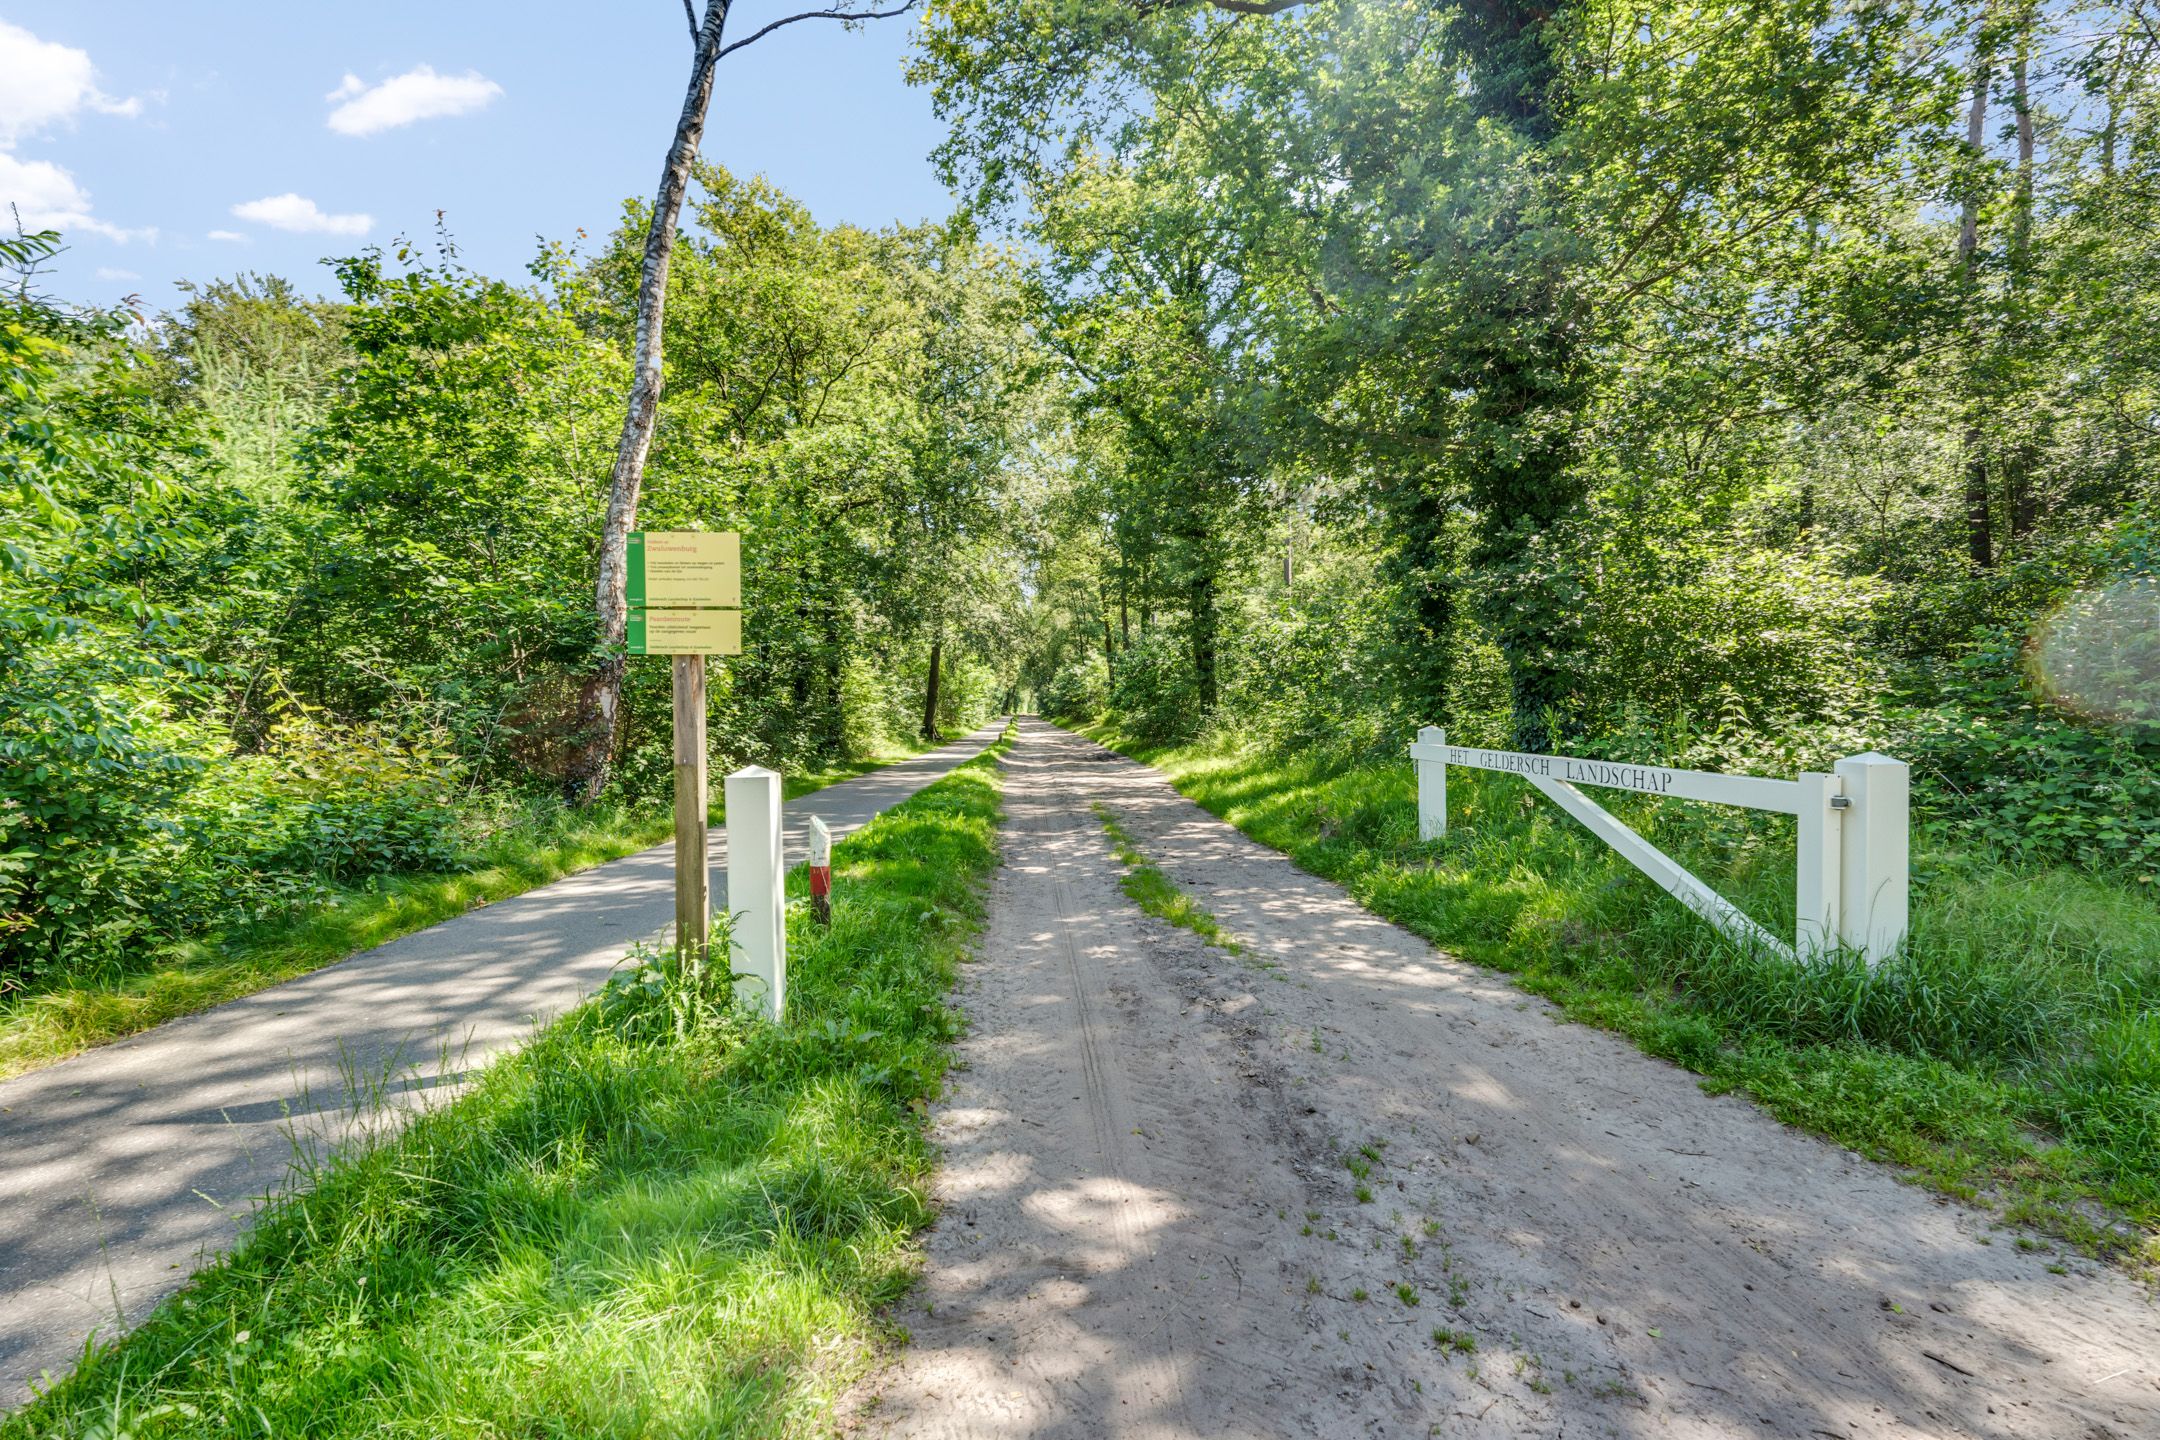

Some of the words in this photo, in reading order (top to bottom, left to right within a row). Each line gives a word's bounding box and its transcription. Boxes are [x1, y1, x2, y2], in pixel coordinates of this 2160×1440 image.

[1450, 749, 1469, 765] HET
[1480, 752, 1550, 776] GELDERSCH
[1566, 761, 1672, 792] LANDSCHAP
